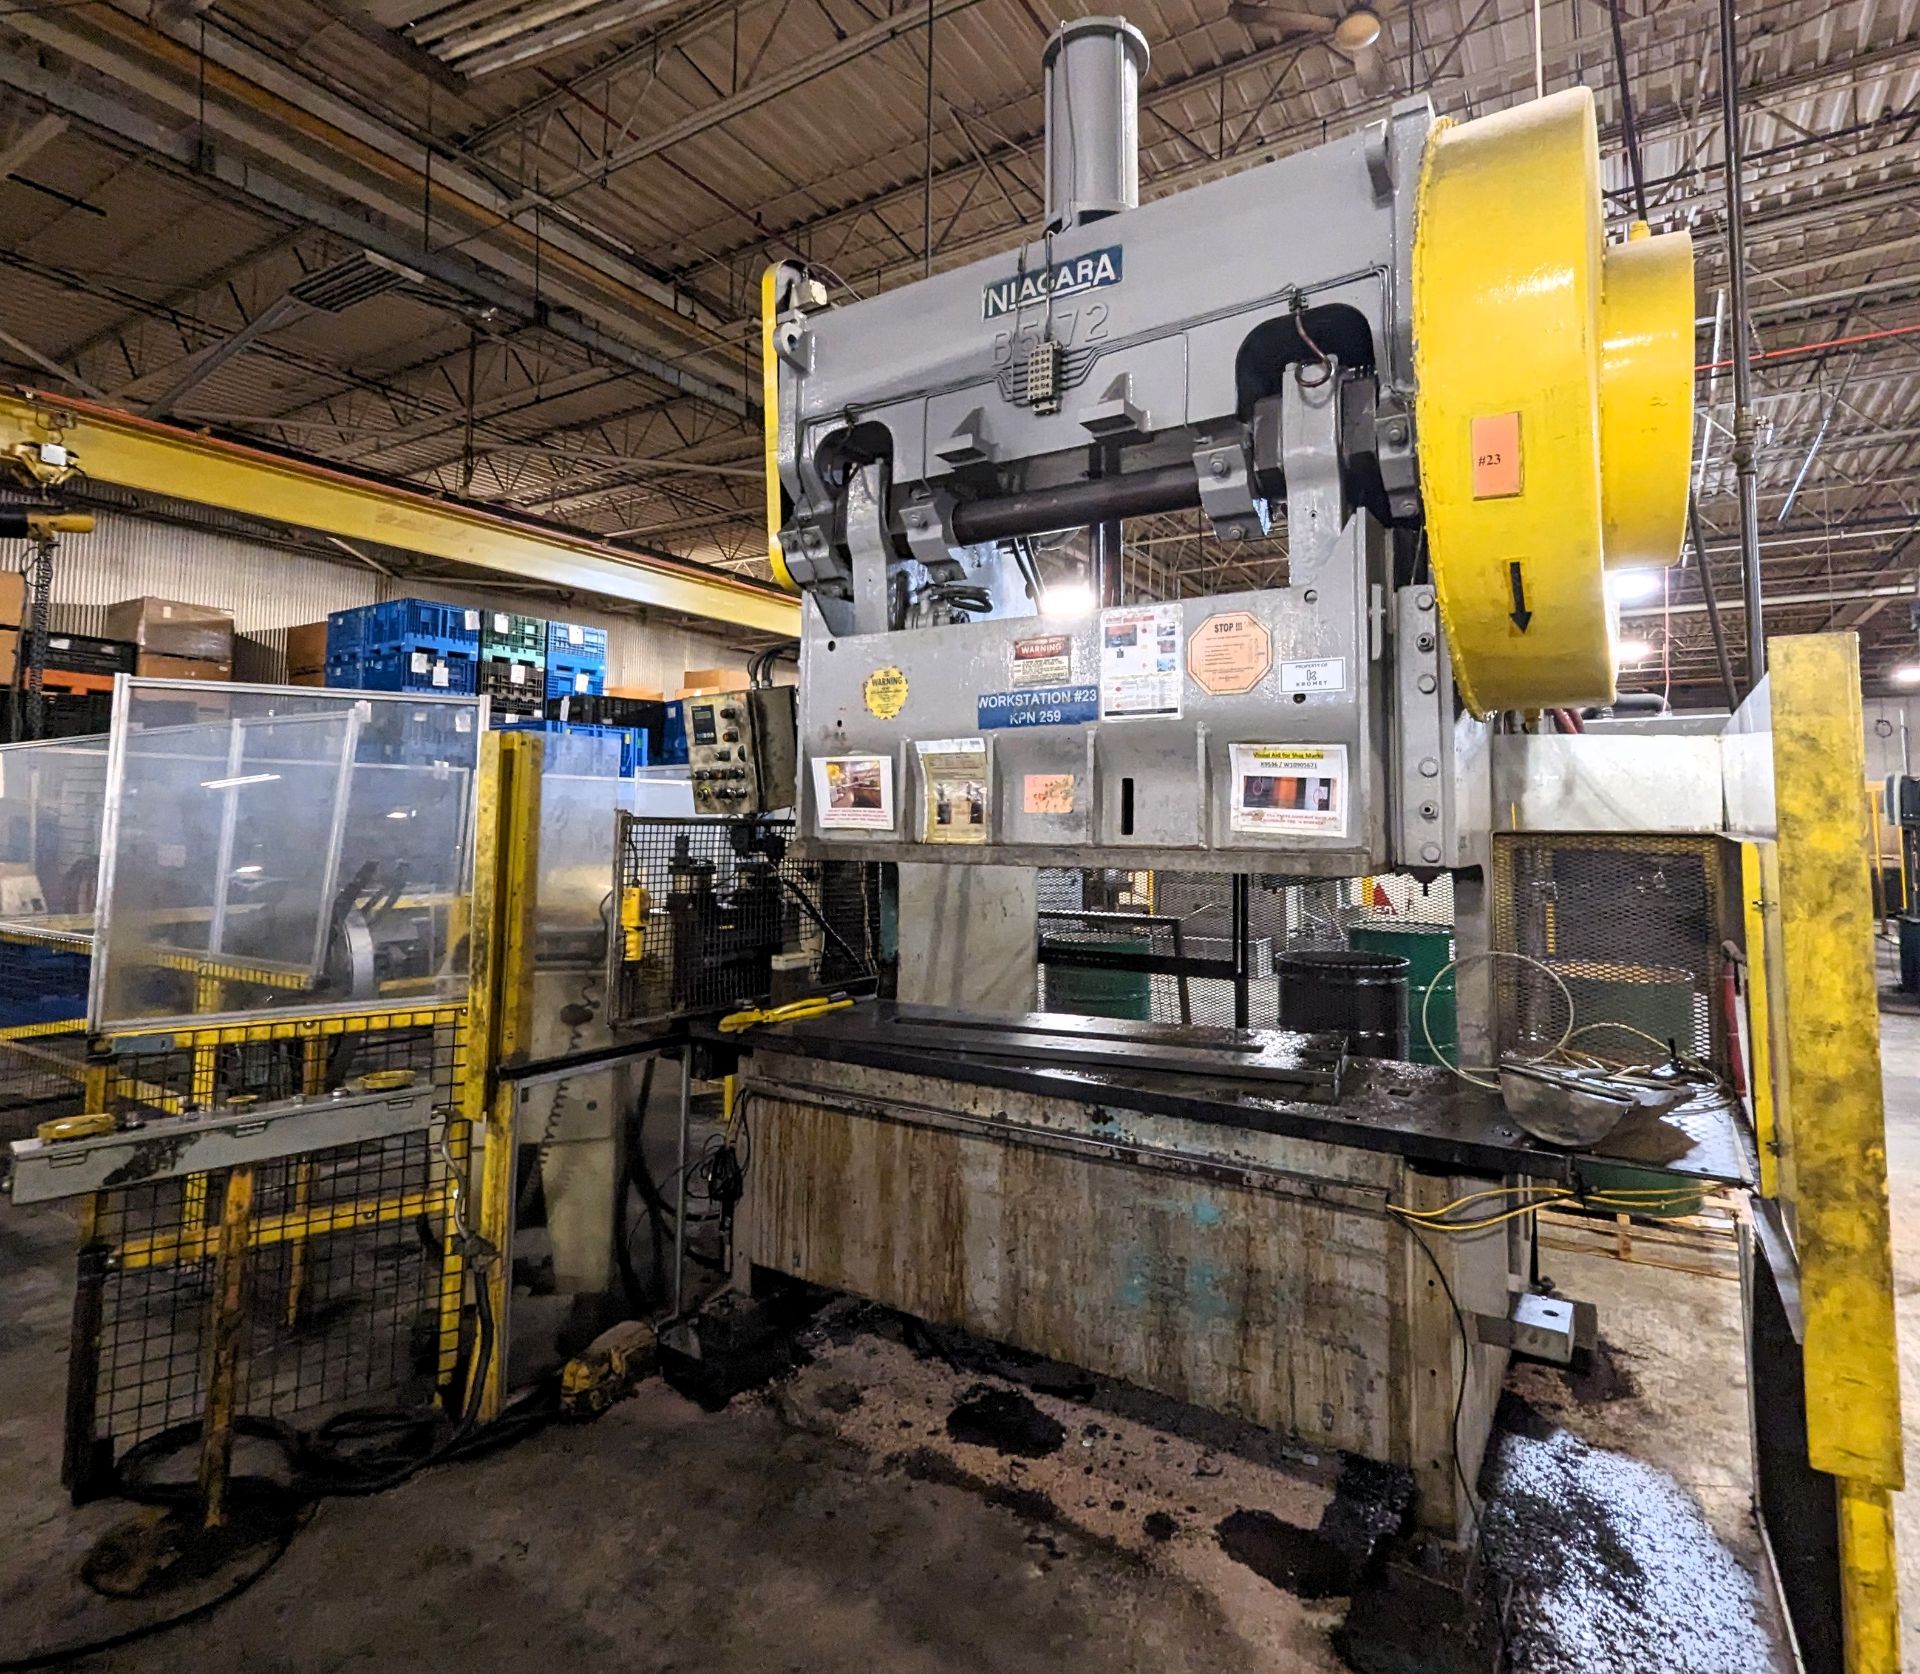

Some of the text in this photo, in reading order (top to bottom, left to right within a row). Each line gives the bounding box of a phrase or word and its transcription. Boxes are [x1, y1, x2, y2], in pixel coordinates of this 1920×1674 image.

[987, 253, 1116, 316] NIAGARA
[1478, 453, 1502, 467] #23
[1214, 622, 1234, 633] STOP
[1020, 643, 1062, 654] WARNING
[872, 677, 903, 686] WARNING
[979, 691, 1071, 709] WORKSTATION
[1073, 689, 1097, 703] #23
[1009, 710, 1062, 725] KPN 259
